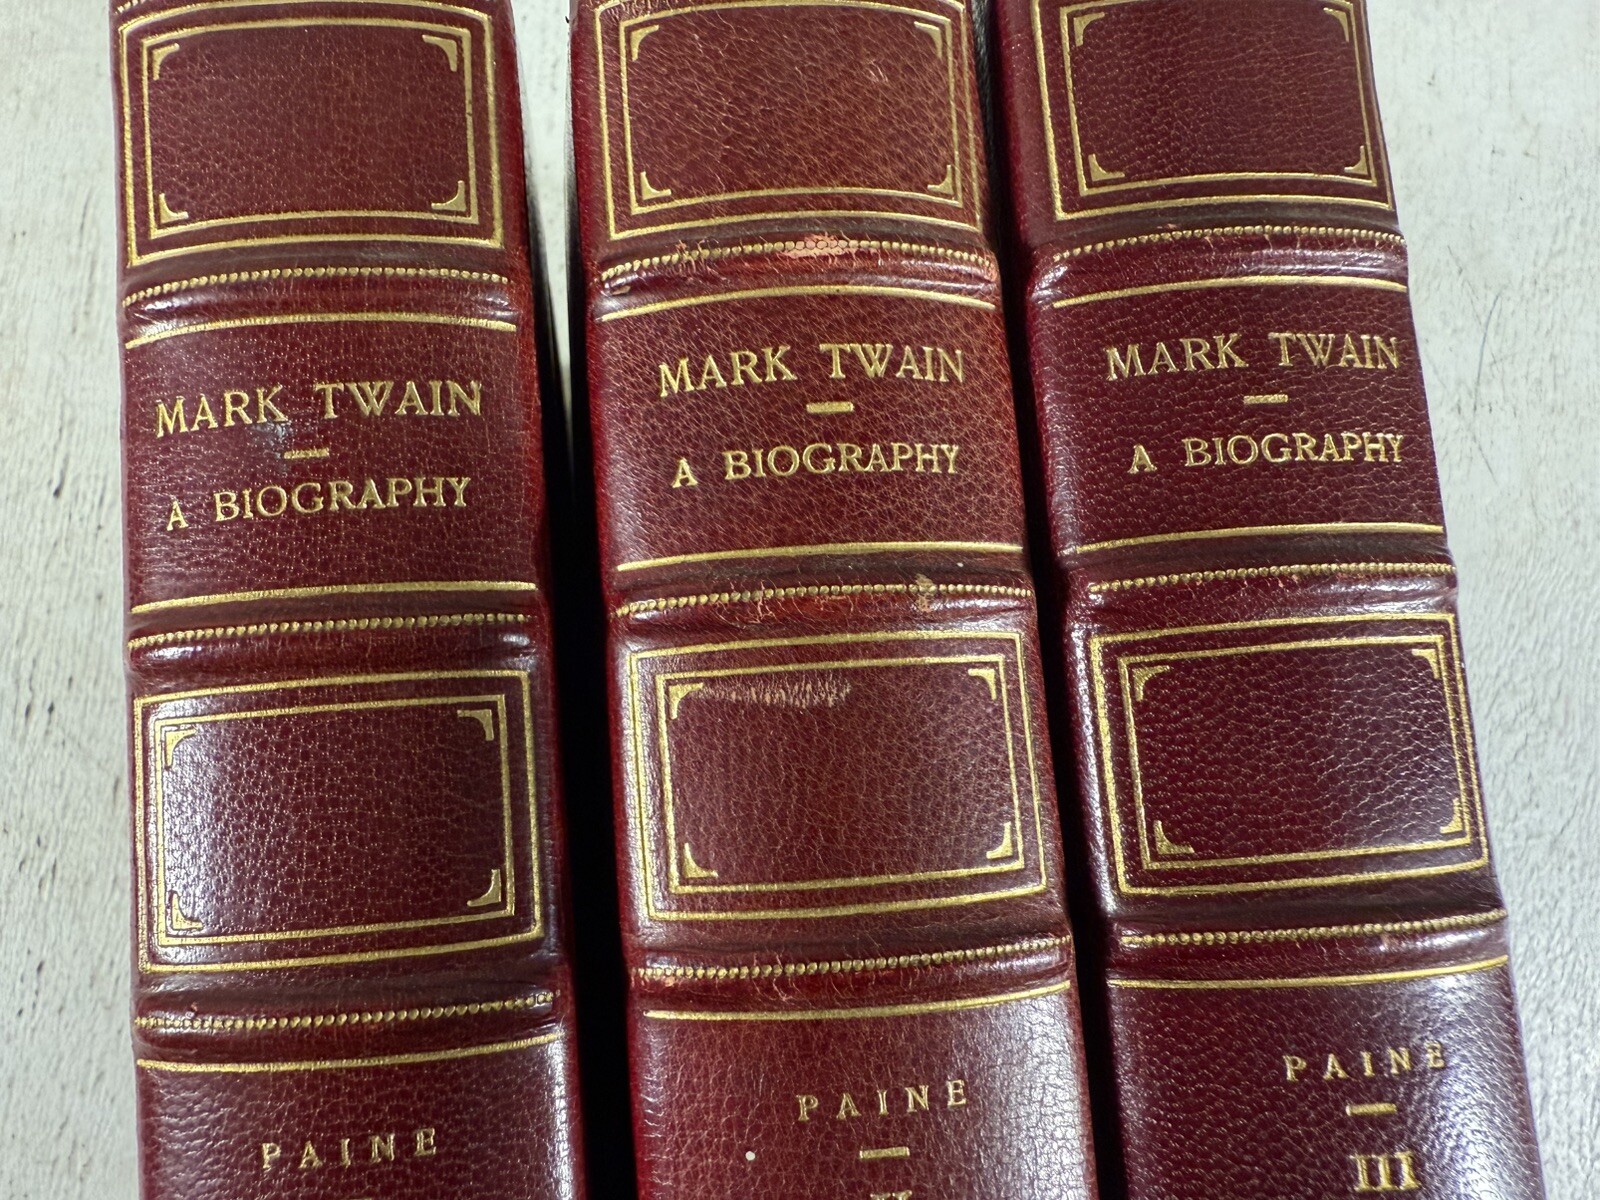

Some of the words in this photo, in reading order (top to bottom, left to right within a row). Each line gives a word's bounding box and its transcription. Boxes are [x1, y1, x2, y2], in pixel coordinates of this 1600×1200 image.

[658, 345, 798, 398] MARK
[819, 343, 965, 384] TWAIN
[1104, 333, 1249, 381] MARK
[1268, 332, 1400, 369] TWAIN
[156, 384, 288, 438] MARK
[312, 380, 482, 419] TWAIN
[671, 457, 698, 488] A
[721, 442, 959, 481] BIOGRAPHY
[1128, 444, 1157, 474] A
[1181, 431, 1404, 467] BIOGRAPHY
[166, 499, 188, 531] A
[213, 476, 471, 522] BIOGRAPHY
[1283, 1040, 1445, 1082] PAINE
[796, 1079, 967, 1121] PAINE
[261, 1127, 436, 1169] PAINE
[1349, 1150, 1422, 1192] III
